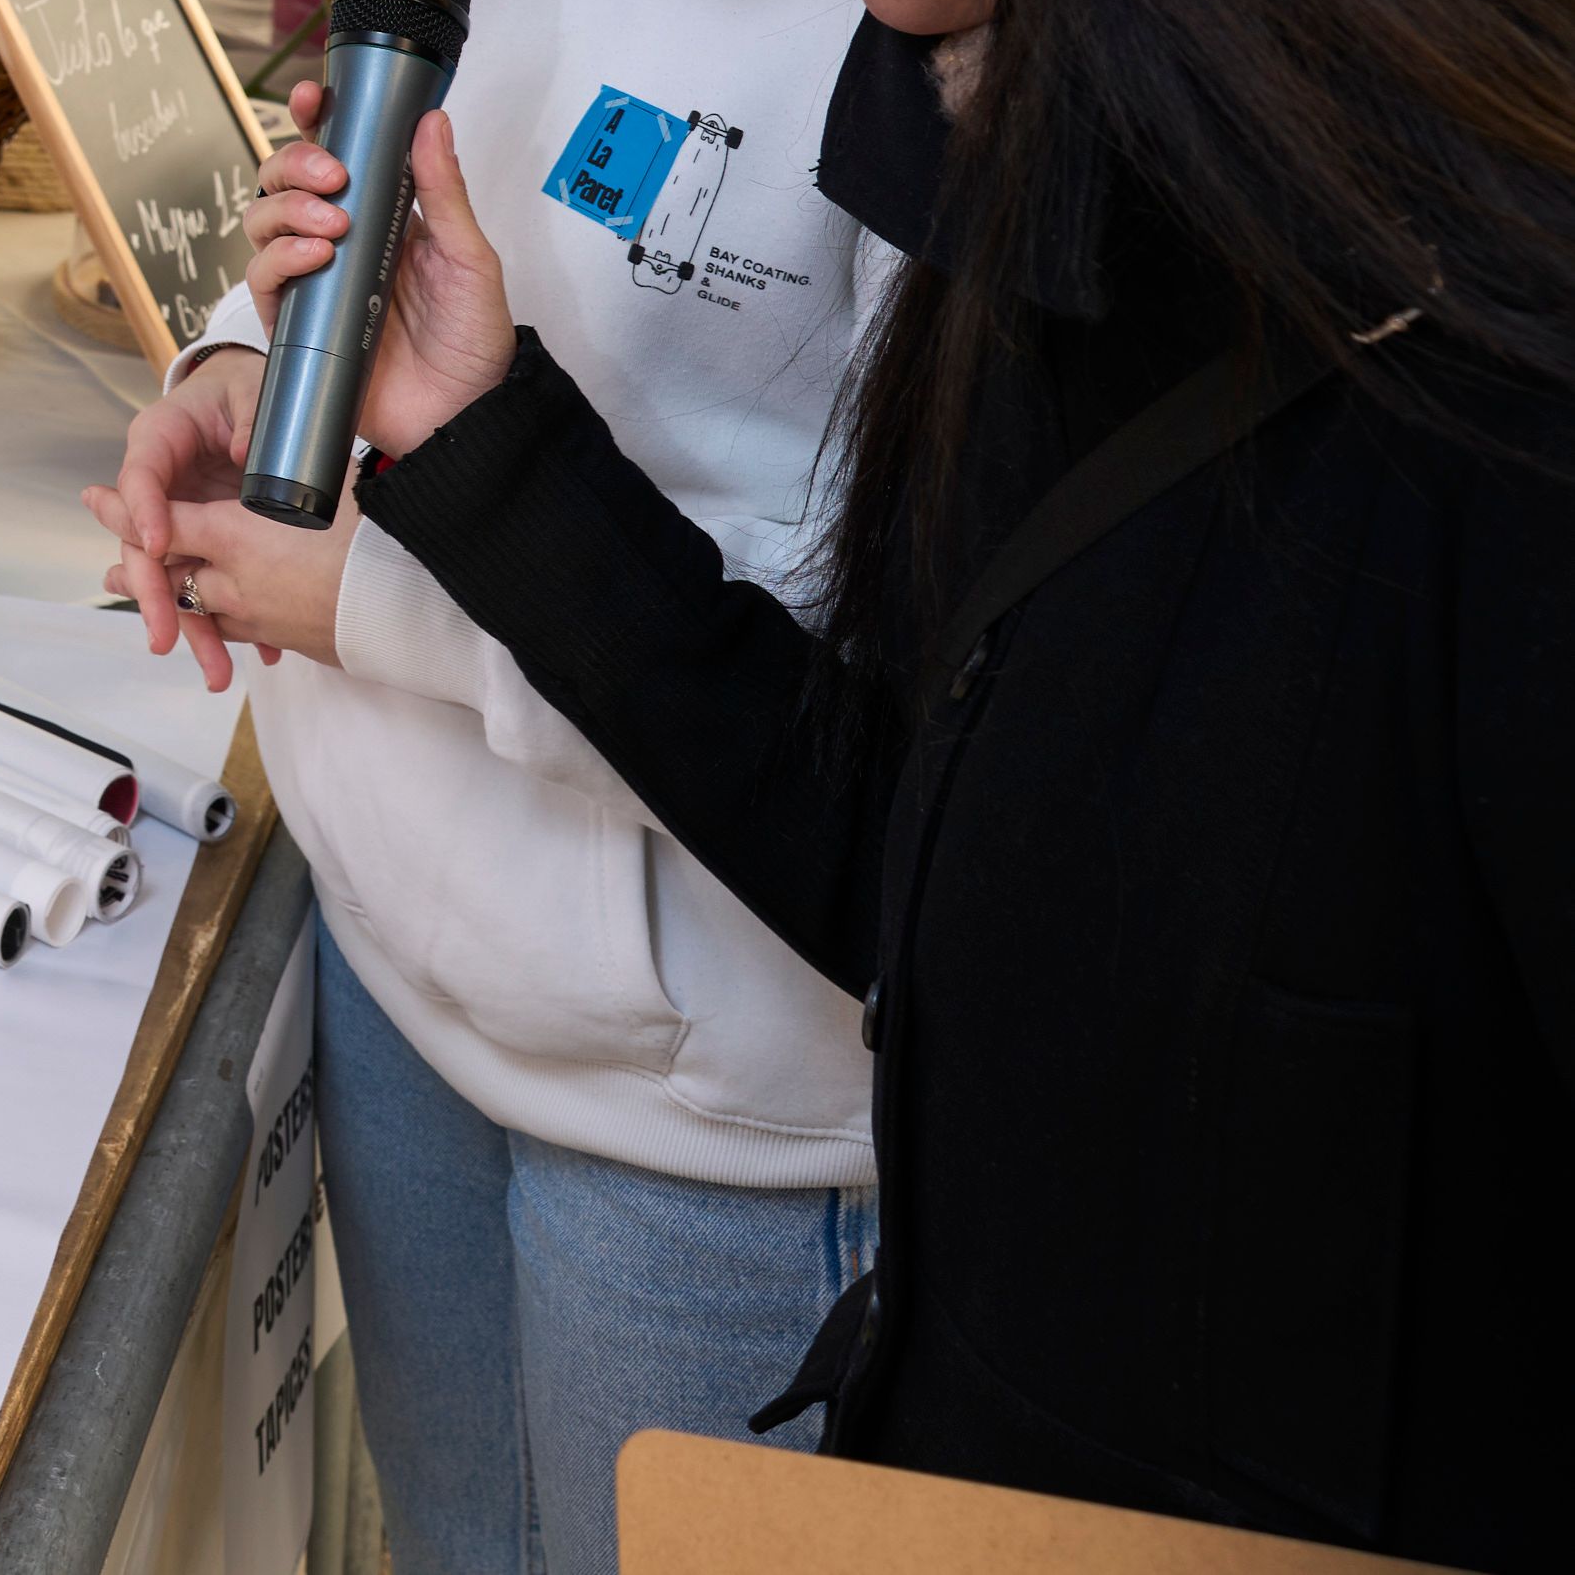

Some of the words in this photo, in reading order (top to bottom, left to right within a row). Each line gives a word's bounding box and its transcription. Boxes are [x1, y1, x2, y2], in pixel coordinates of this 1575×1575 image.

[604, 108, 625, 135] A
[586, 138, 613, 170] La
[569, 170, 625, 216] Paret
[379, 176, 410, 282] SENNHEISER
[704, 262, 767, 291] SHANKS
[709, 247, 741, 265] BAY
[742, 259, 812, 286] COATING.
[700, 277, 711, 287] &
[697, 289, 742, 312] GLIDE
